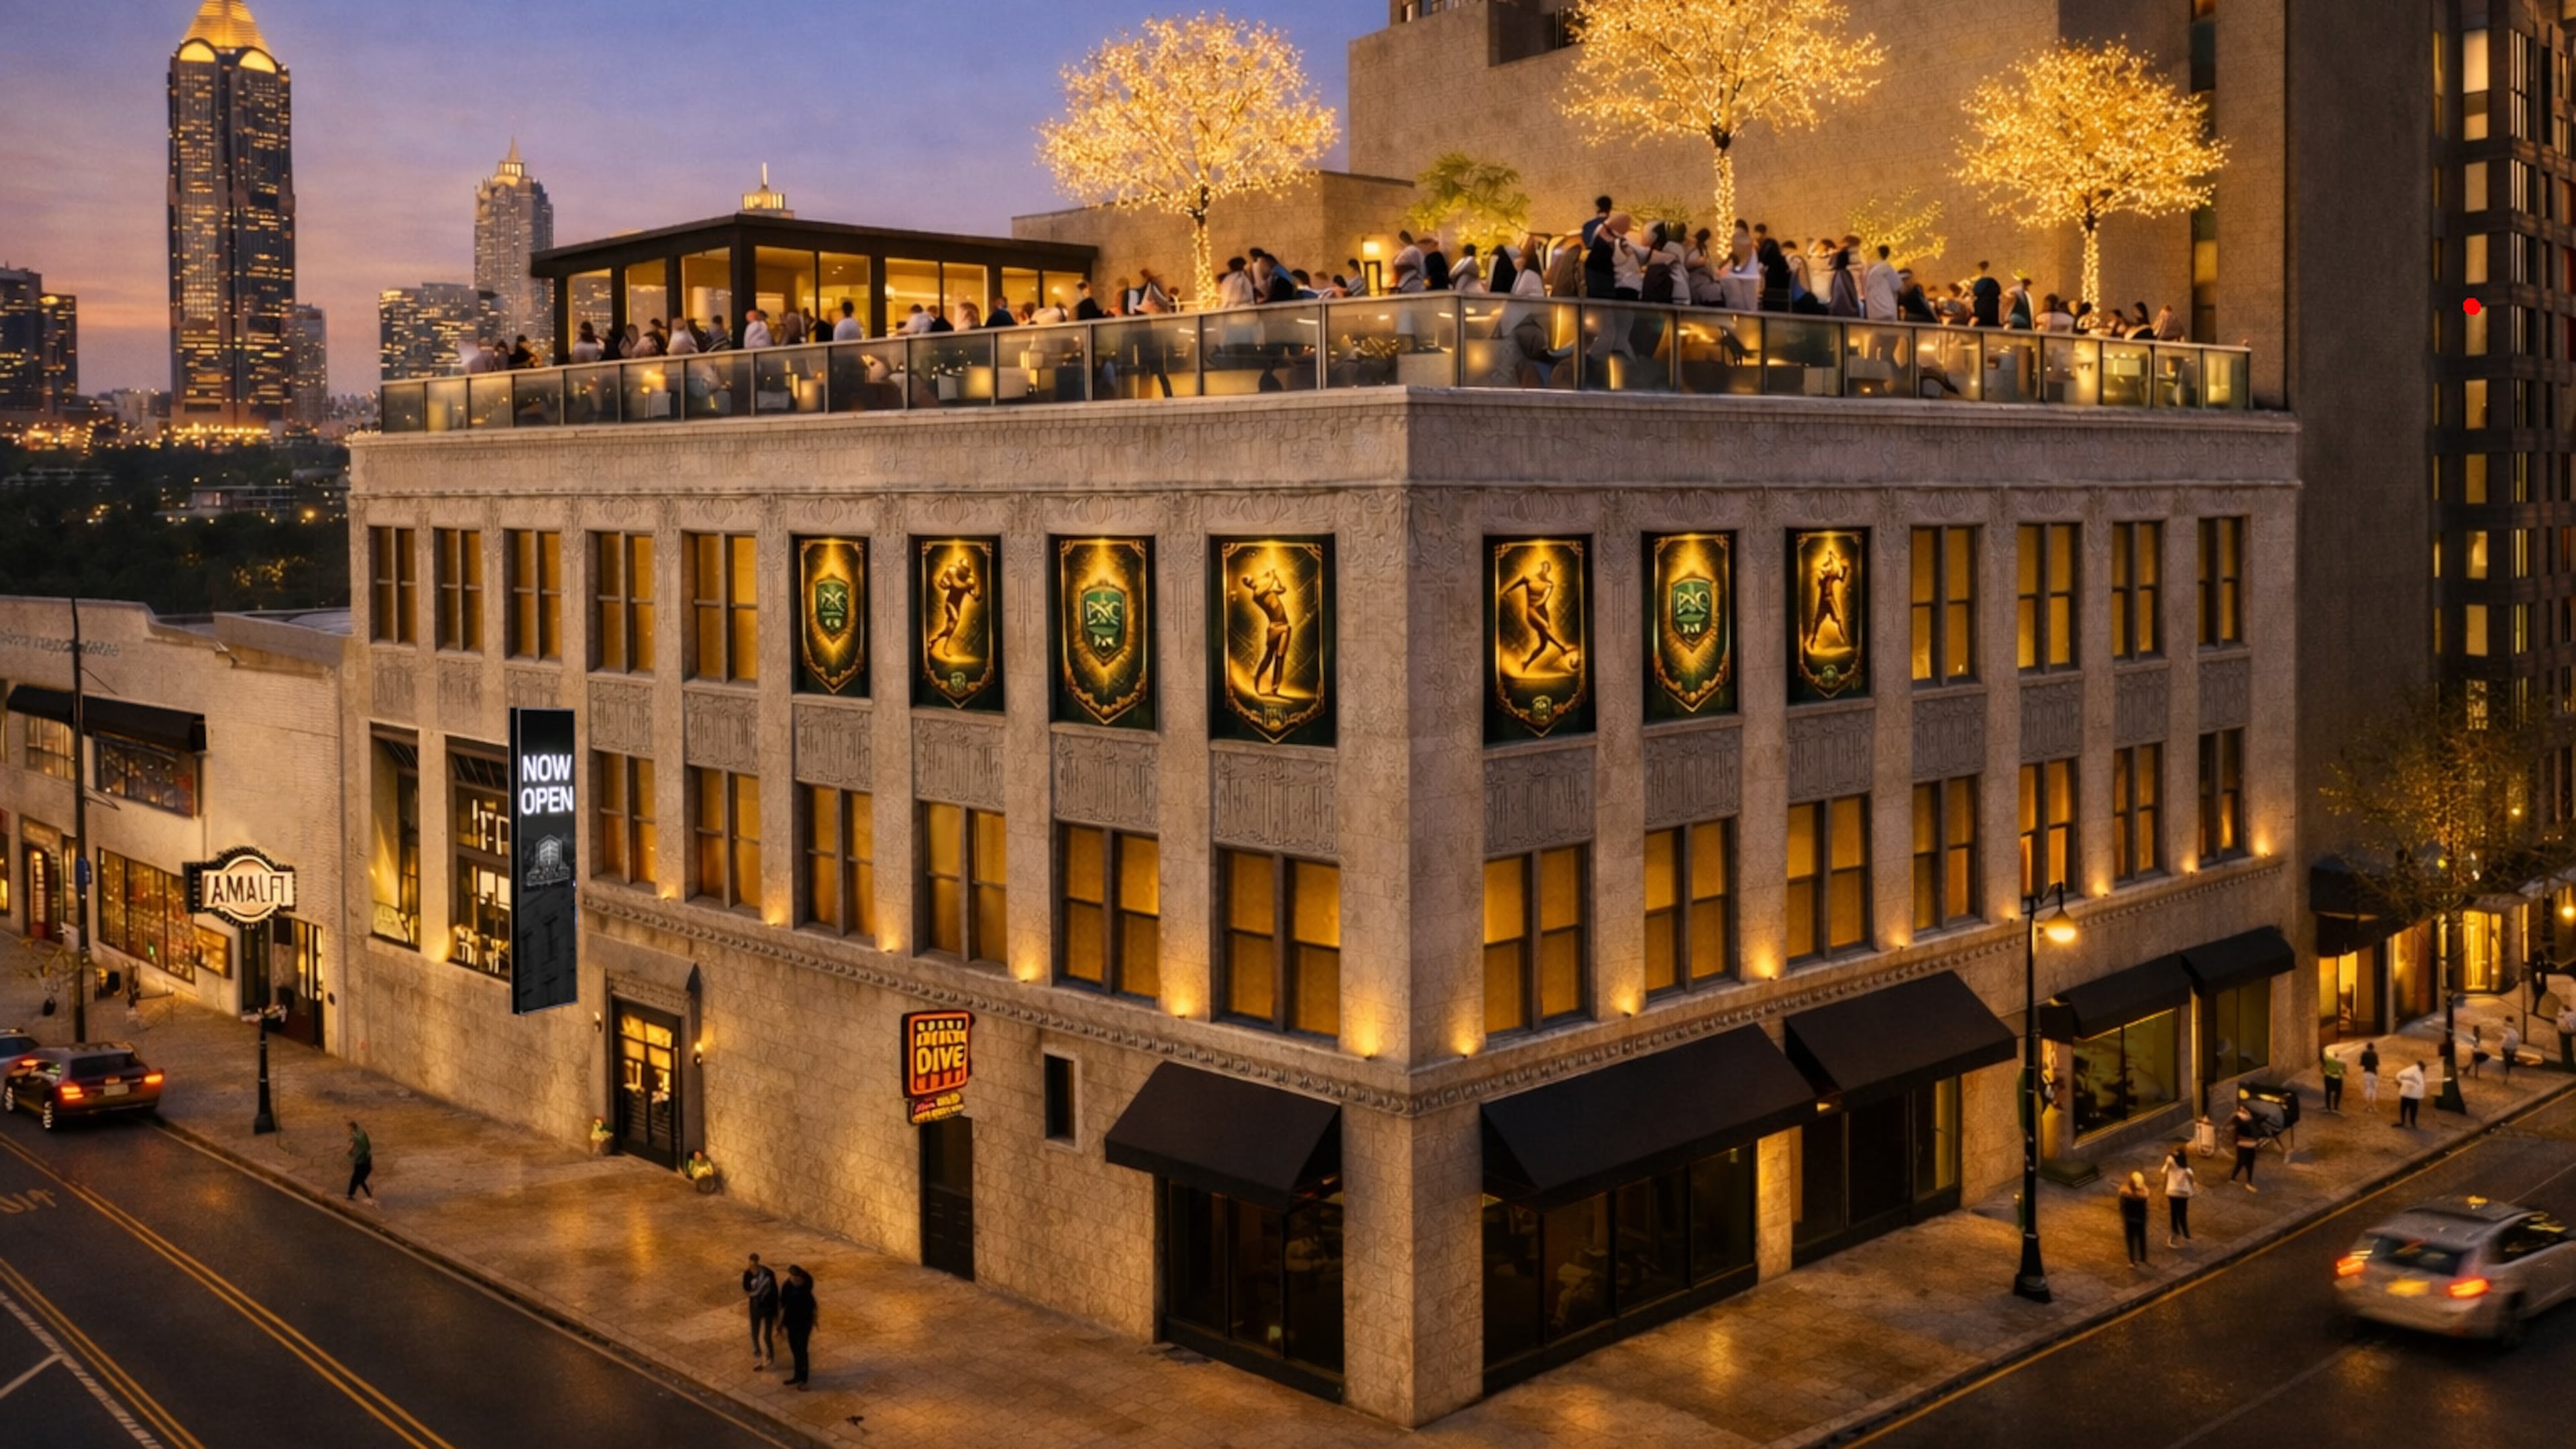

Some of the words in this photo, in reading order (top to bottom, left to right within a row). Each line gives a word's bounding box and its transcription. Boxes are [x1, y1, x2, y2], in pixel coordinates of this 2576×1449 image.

[523, 754, 572, 782] NOW
[521, 786, 574, 815] OPEN
[916, 1045, 964, 1075] DIVE
